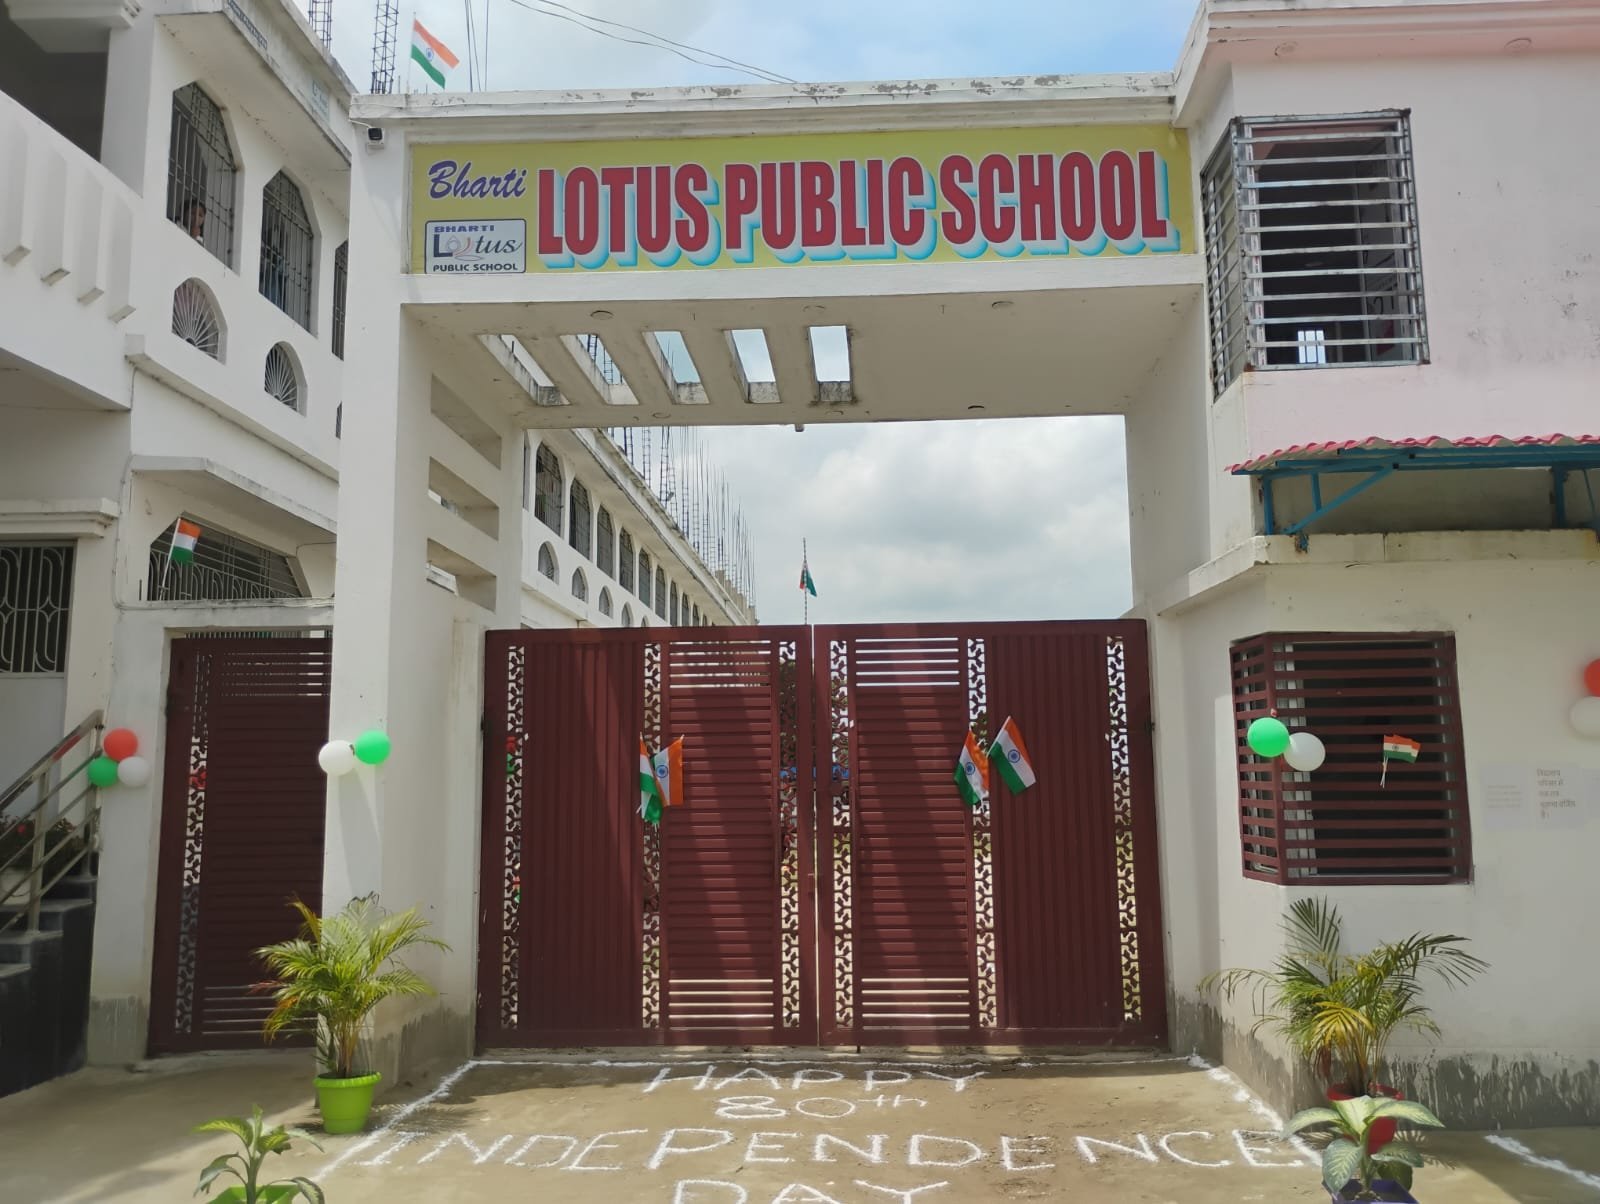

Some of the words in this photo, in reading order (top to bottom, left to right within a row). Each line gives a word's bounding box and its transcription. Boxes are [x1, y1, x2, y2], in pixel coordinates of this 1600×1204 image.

[429, 160, 527, 199] Bharti
[538, 163, 711, 256] LOTUS
[724, 155, 926, 250] PUBLIC
[939, 150, 1168, 245] SCHOOL
[434, 225, 495, 233] BHARTI
[433, 264, 469, 272] PUBLIC
[473, 263, 518, 271] SCHOOL
[643, 1064, 989, 1093] HAPPY
[714, 1094, 928, 1119] 80th
[350, 1127, 1303, 1171] INDEPENDENCE
[672, 1178, 950, 1204] DAY
